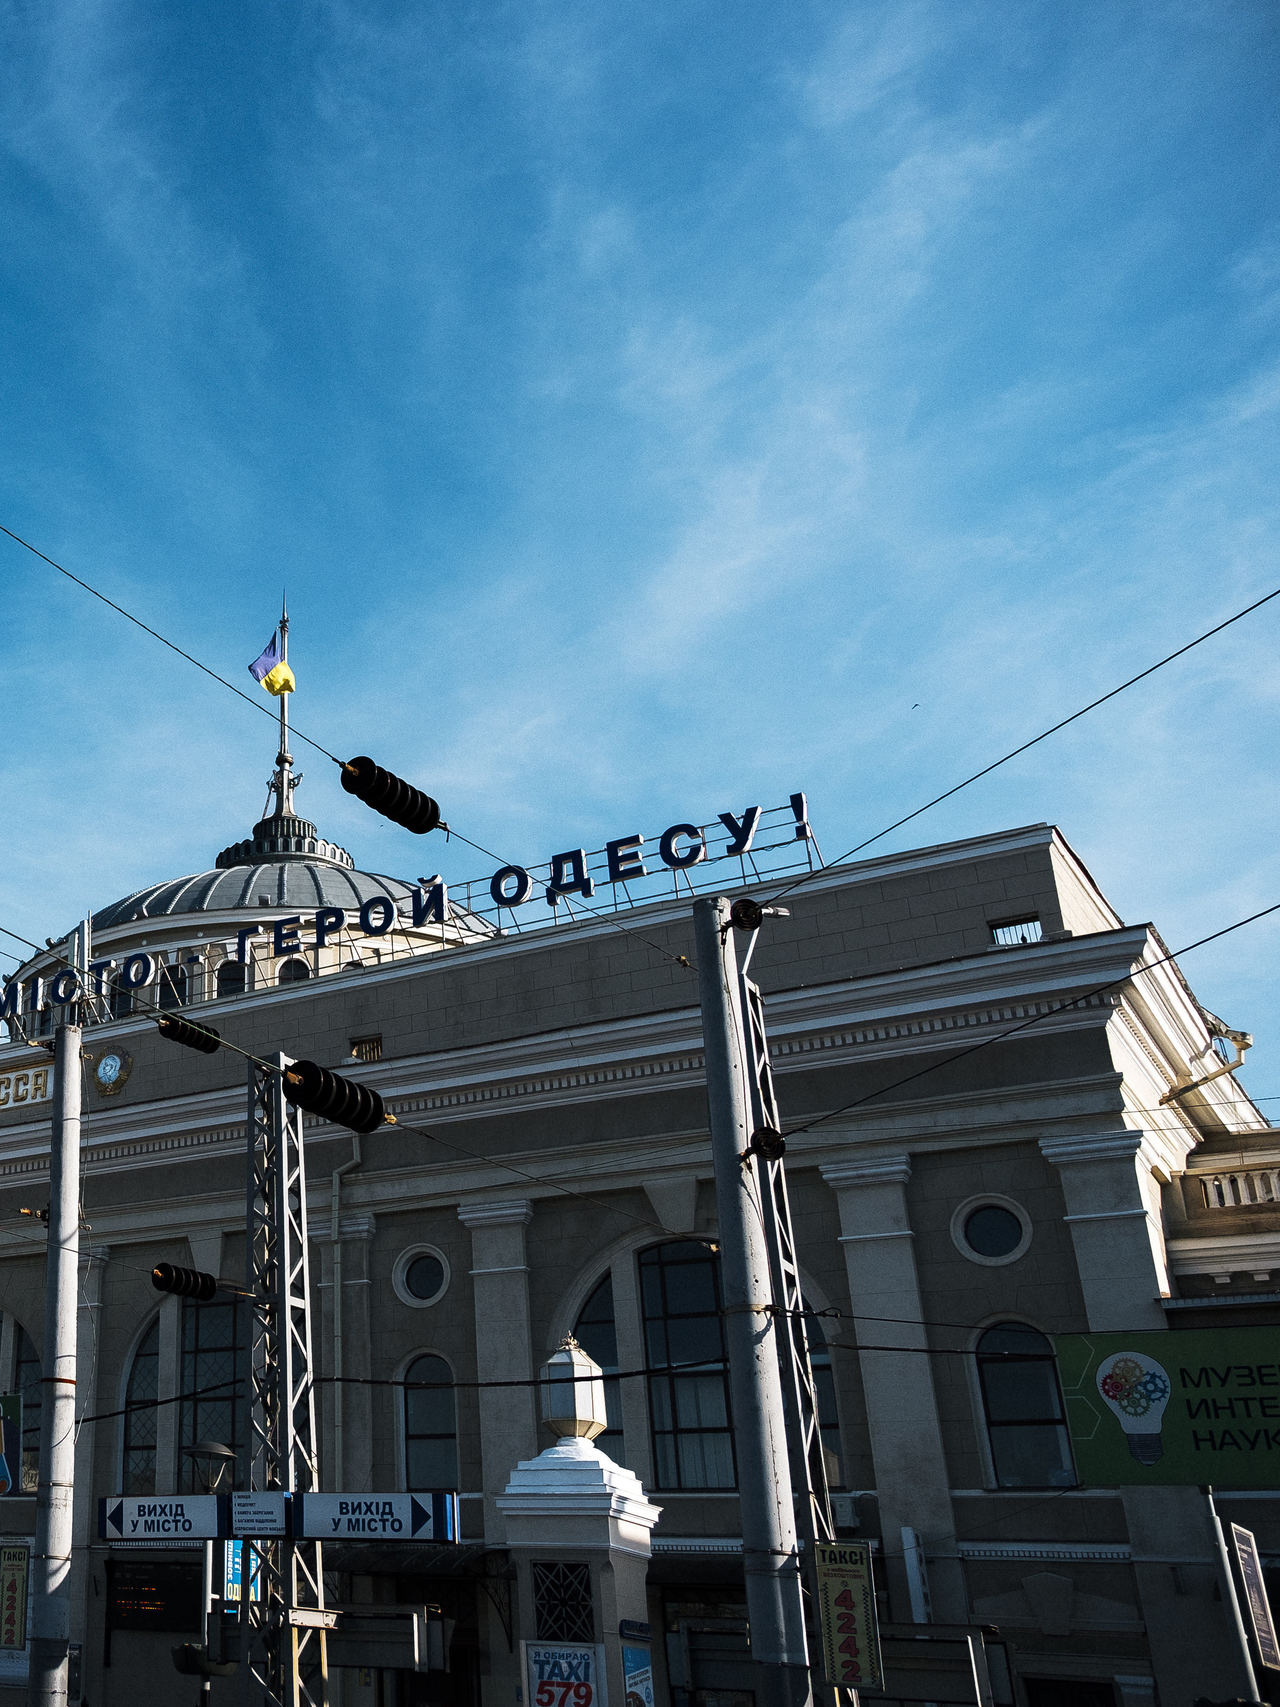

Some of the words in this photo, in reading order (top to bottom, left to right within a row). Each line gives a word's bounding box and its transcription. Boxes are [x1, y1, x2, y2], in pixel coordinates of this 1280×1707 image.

[237, 874, 451, 965] ГЕРОЙ
[490, 792, 813, 907] ОДЕСУ!
[137, 1504, 185, 1519] ВИХІД
[339, 1501, 394, 1518] ВИХІД
[131, 1520, 140, 1533] У
[144, 1519, 193, 1533] МІСТО
[332, 1518, 341, 1532] У
[347, 1518, 403, 1532] МІСТО
[3, 1551, 26, 1562] ТАКСІ
[820, 1550, 864, 1566] ТАКСІ
[4, 1578, 17, 1645] 4242
[834, 1588, 862, 1683] 4242
[534, 1651, 541, 1659] Я
[543, 1651, 590, 1661] ОБИРАЮ
[534, 1660, 591, 1682] TAXI
[536, 1681, 593, 1707] 579
